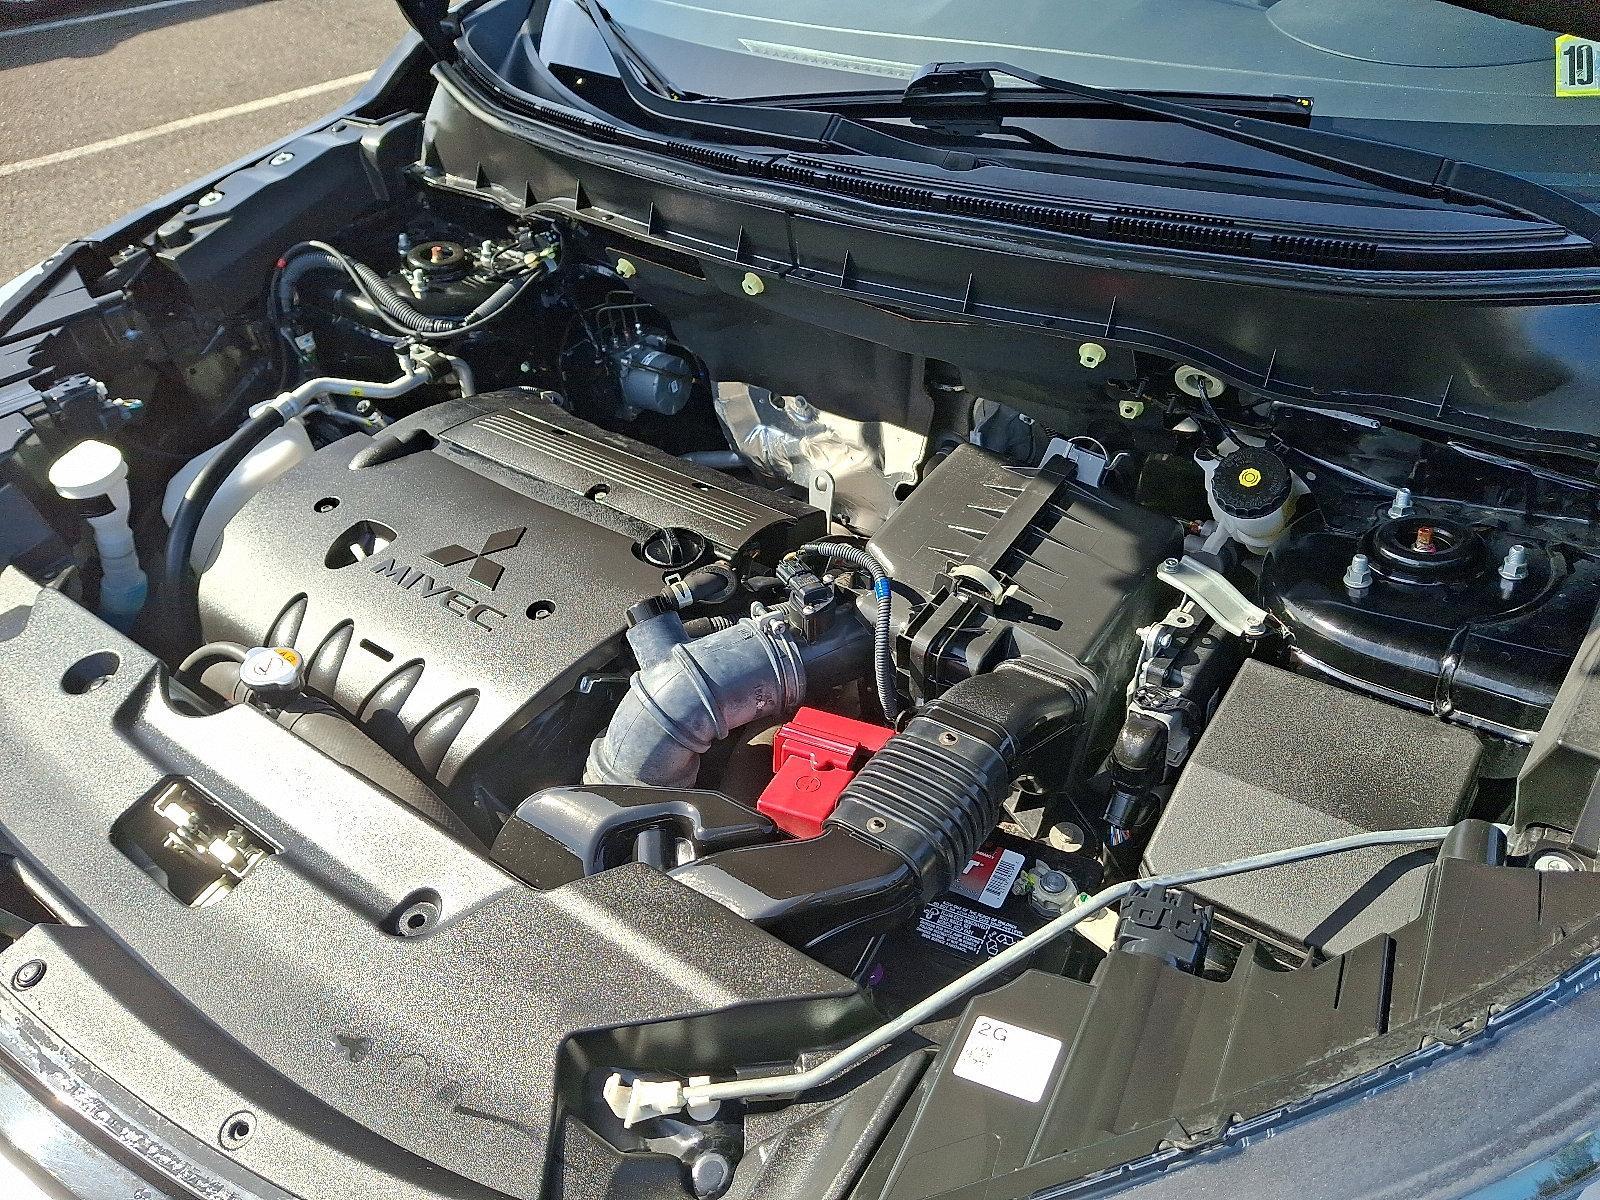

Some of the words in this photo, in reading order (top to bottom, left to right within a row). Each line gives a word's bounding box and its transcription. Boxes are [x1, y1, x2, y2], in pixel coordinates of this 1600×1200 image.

[1563, 44, 1594, 86] 10
[369, 558, 508, 633] MIVEC
[978, 1022, 1008, 1042] 2G
